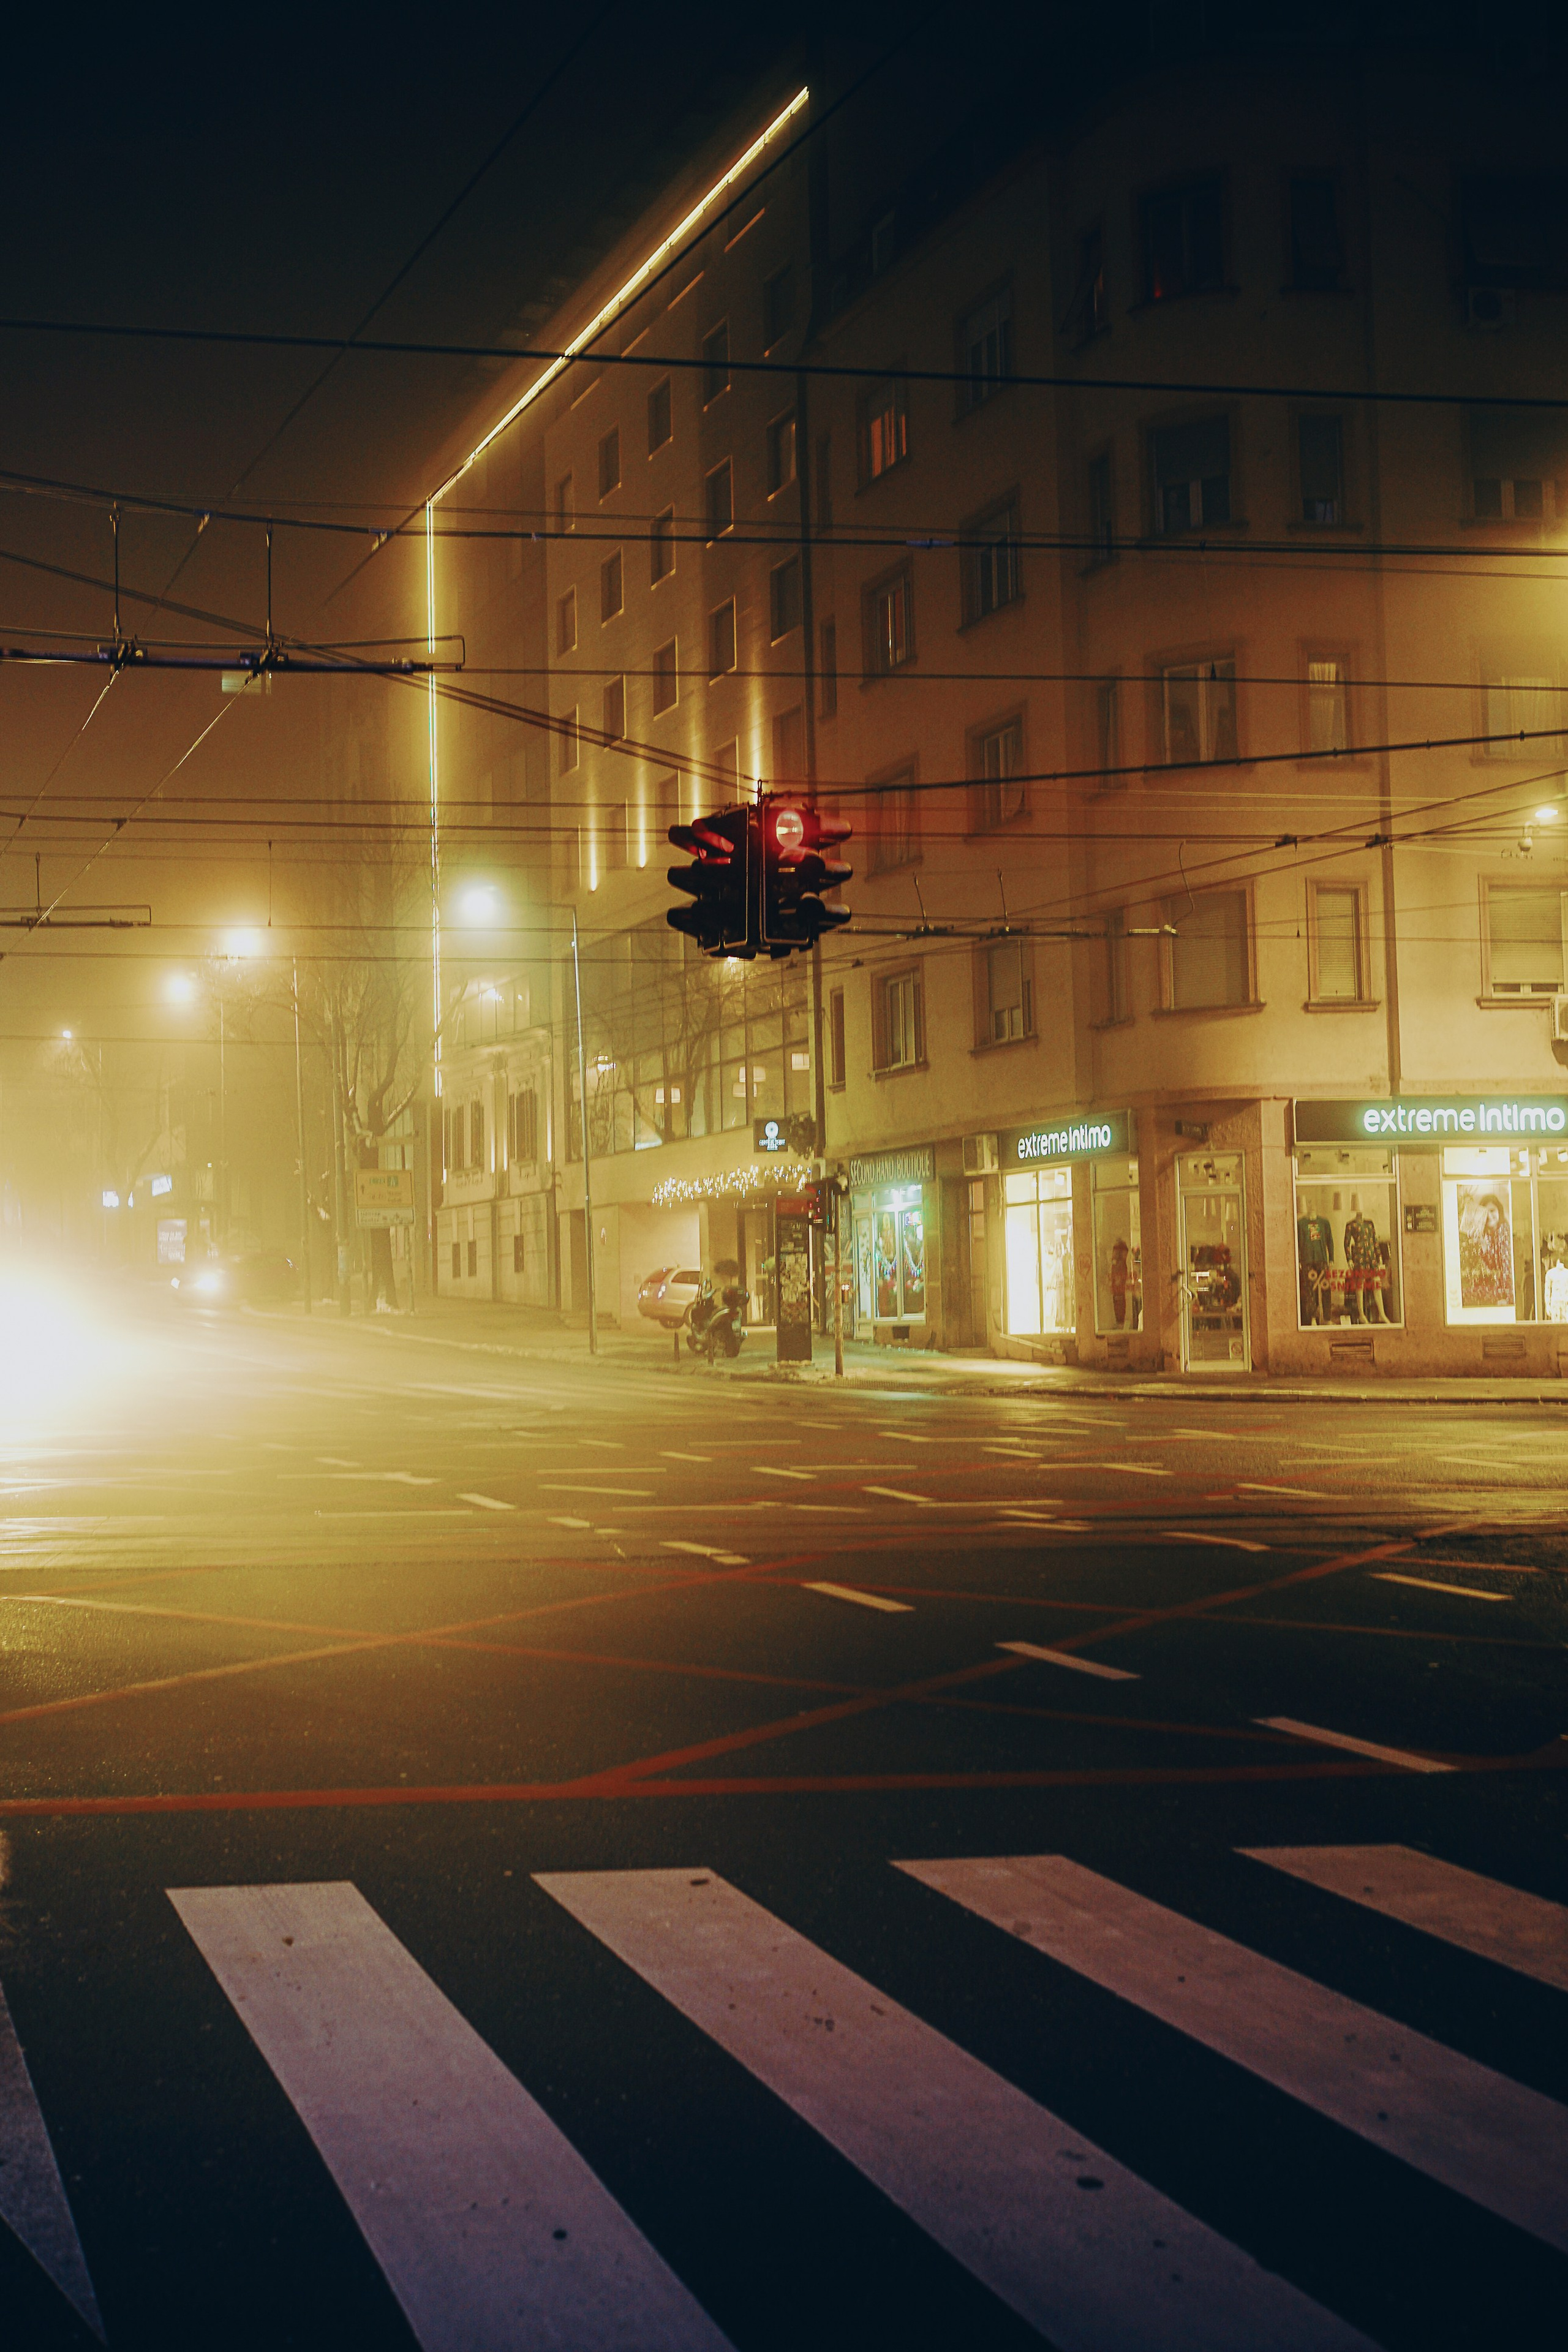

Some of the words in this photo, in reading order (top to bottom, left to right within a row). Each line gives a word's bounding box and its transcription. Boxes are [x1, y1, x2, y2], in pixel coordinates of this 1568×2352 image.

[1364, 1105, 1476, 1133] extreme
[1017, 1132, 1068, 1159] extreme
[850, 1158, 875, 1187] SECOND
[876, 1156, 894, 1183] HAND
[897, 1150, 930, 1180] BOUTIQUE
